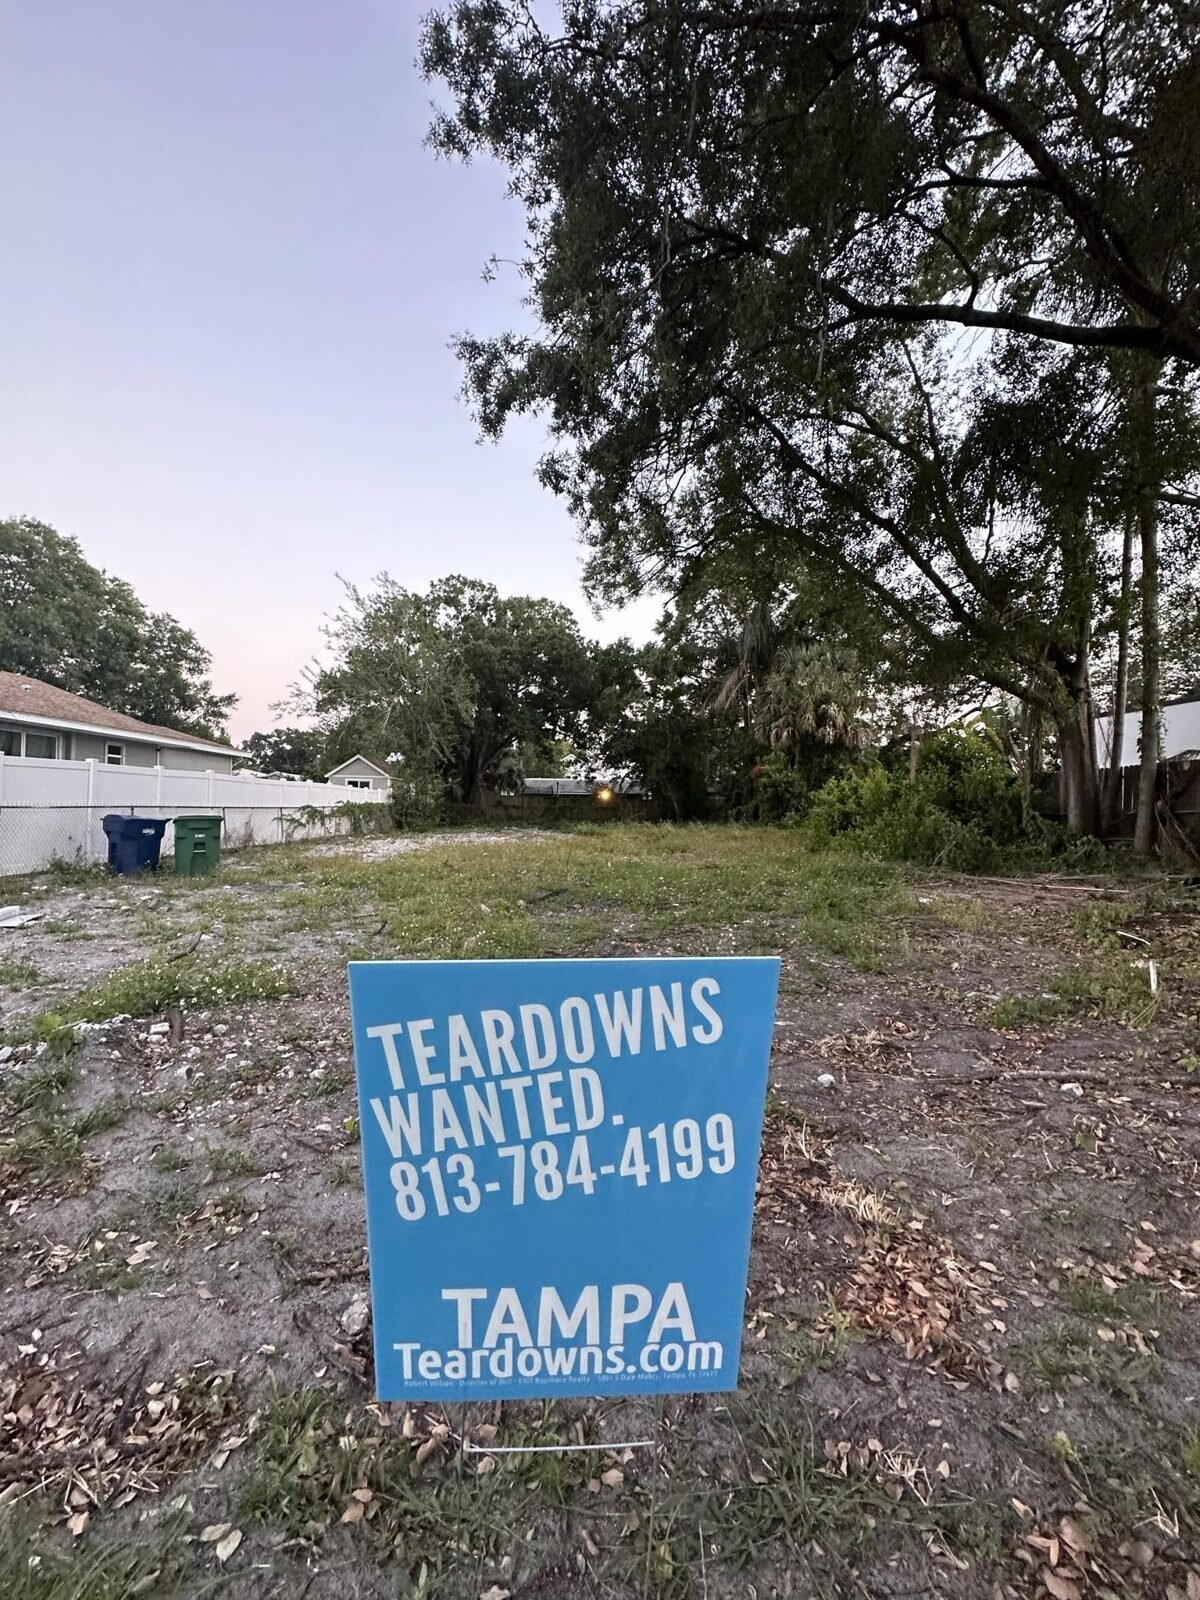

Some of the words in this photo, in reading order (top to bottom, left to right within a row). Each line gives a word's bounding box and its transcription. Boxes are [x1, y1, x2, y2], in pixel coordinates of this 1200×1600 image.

[367, 978, 723, 1090] TEARDOWNS
[370, 1068, 625, 1158] WANTED.
[390, 1114, 735, 1221] 813-784-4199
[393, 1338, 723, 1380] Teardowns.com
[442, 1283, 696, 1348] TAMPA
